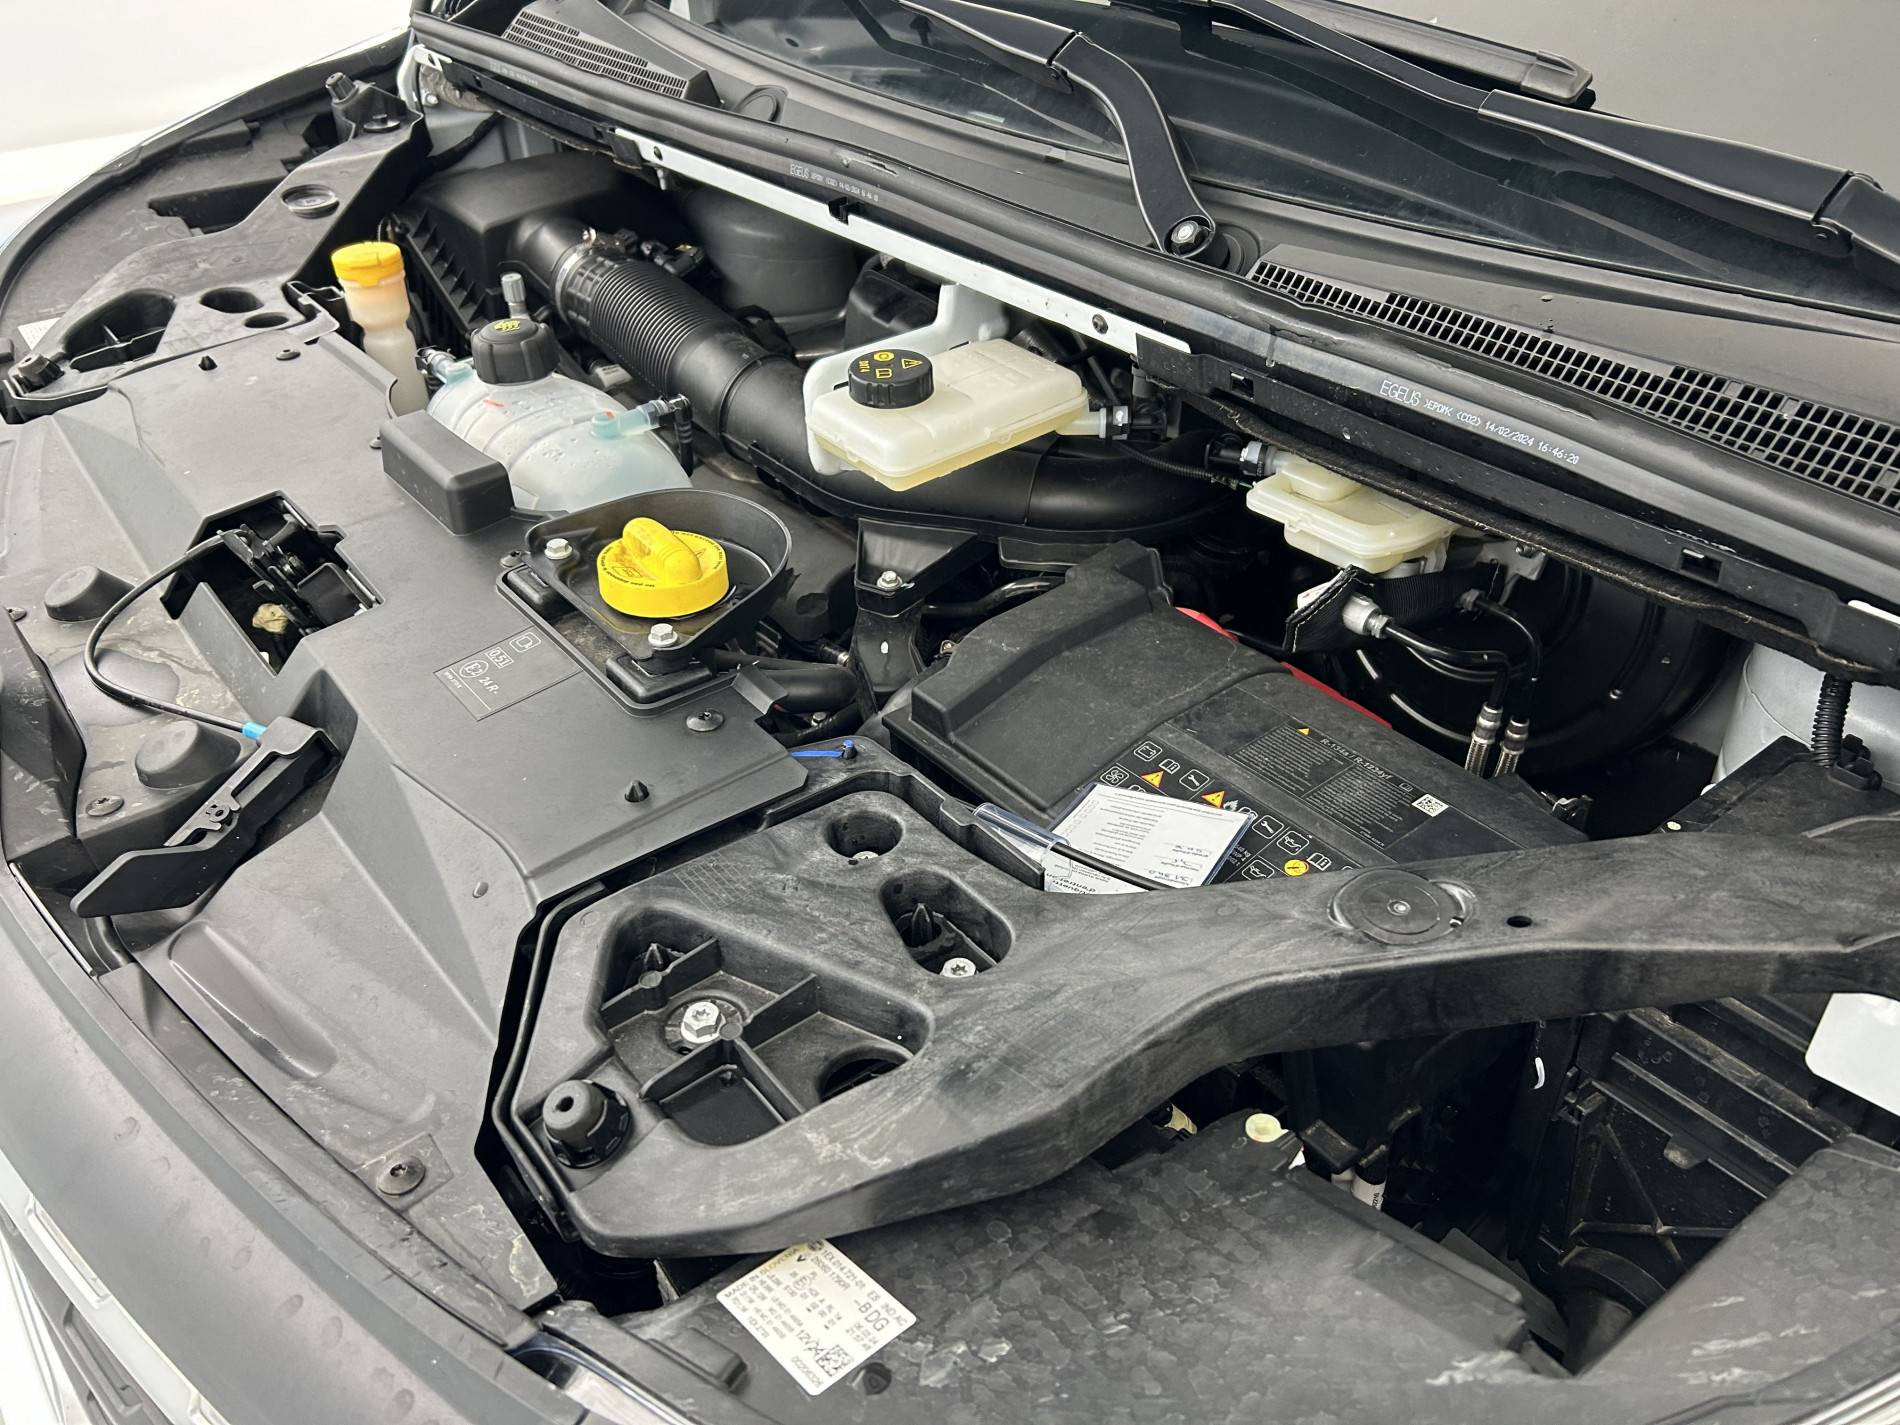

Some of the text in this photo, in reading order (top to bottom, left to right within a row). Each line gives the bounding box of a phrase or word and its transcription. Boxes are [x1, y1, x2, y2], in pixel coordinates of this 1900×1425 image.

[1379, 380, 1422, 407] EGEUS
[1485, 421, 1535, 447] 14/02/2024
[1538, 441, 1580, 465] 16:46:20
[1320, 738, 1350, 757] R-134a
[1354, 756, 1393, 780] R-1234yf
